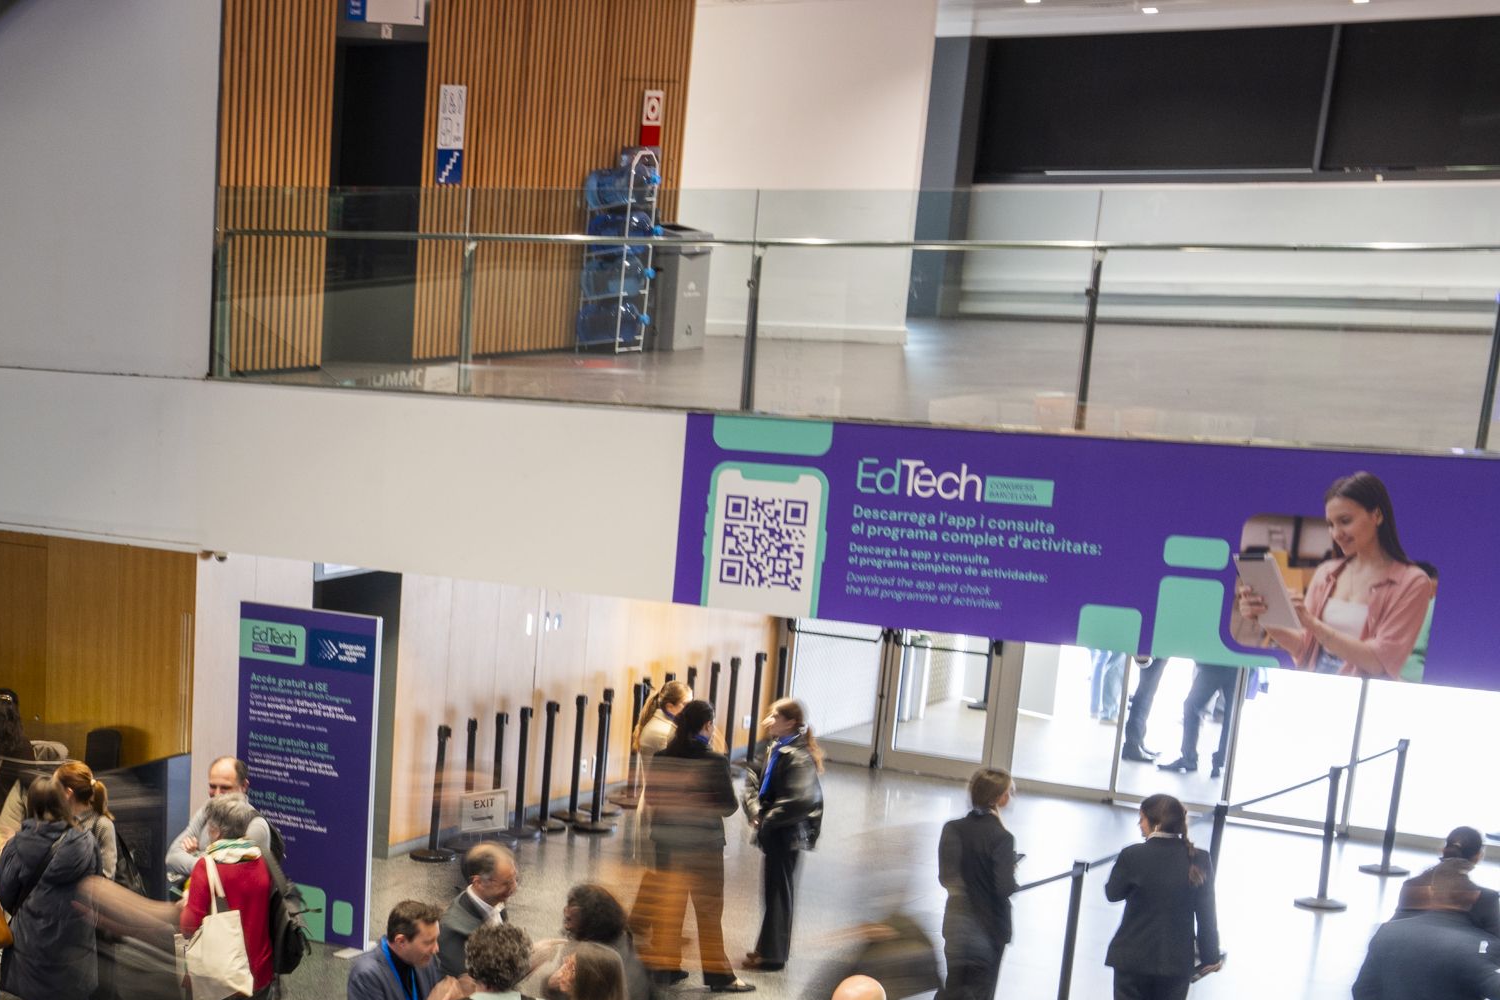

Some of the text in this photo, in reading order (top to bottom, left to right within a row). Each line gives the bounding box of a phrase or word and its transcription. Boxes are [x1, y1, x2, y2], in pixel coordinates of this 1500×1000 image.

[855, 455, 984, 503] EdTech
[989, 481, 1035, 492] CONGRESS
[988, 490, 1038, 502] BARCELONA
[852, 504, 1055, 535] Descarrega l'app i consulta
[851, 521, 1103, 556] el programa complet d'activitats:
[849, 542, 897, 558] Descarga
[899, 546, 909, 557] la
[910, 550, 932, 562] app
[942, 553, 990, 565] consulta
[848, 555, 858, 565] el
[859, 558, 910, 570] programa
[911, 562, 962, 575] completo
[964, 565, 978, 577] de
[846, 571, 992, 596] Download the app and check
[252, 625, 297, 646] EdTech
[251, 673, 277, 684] Accés
[315, 682, 328, 692] ISE
[249, 731, 277, 744] Acceso
[316, 742, 328, 752] ISE
[474, 798, 495, 809] EXIT
